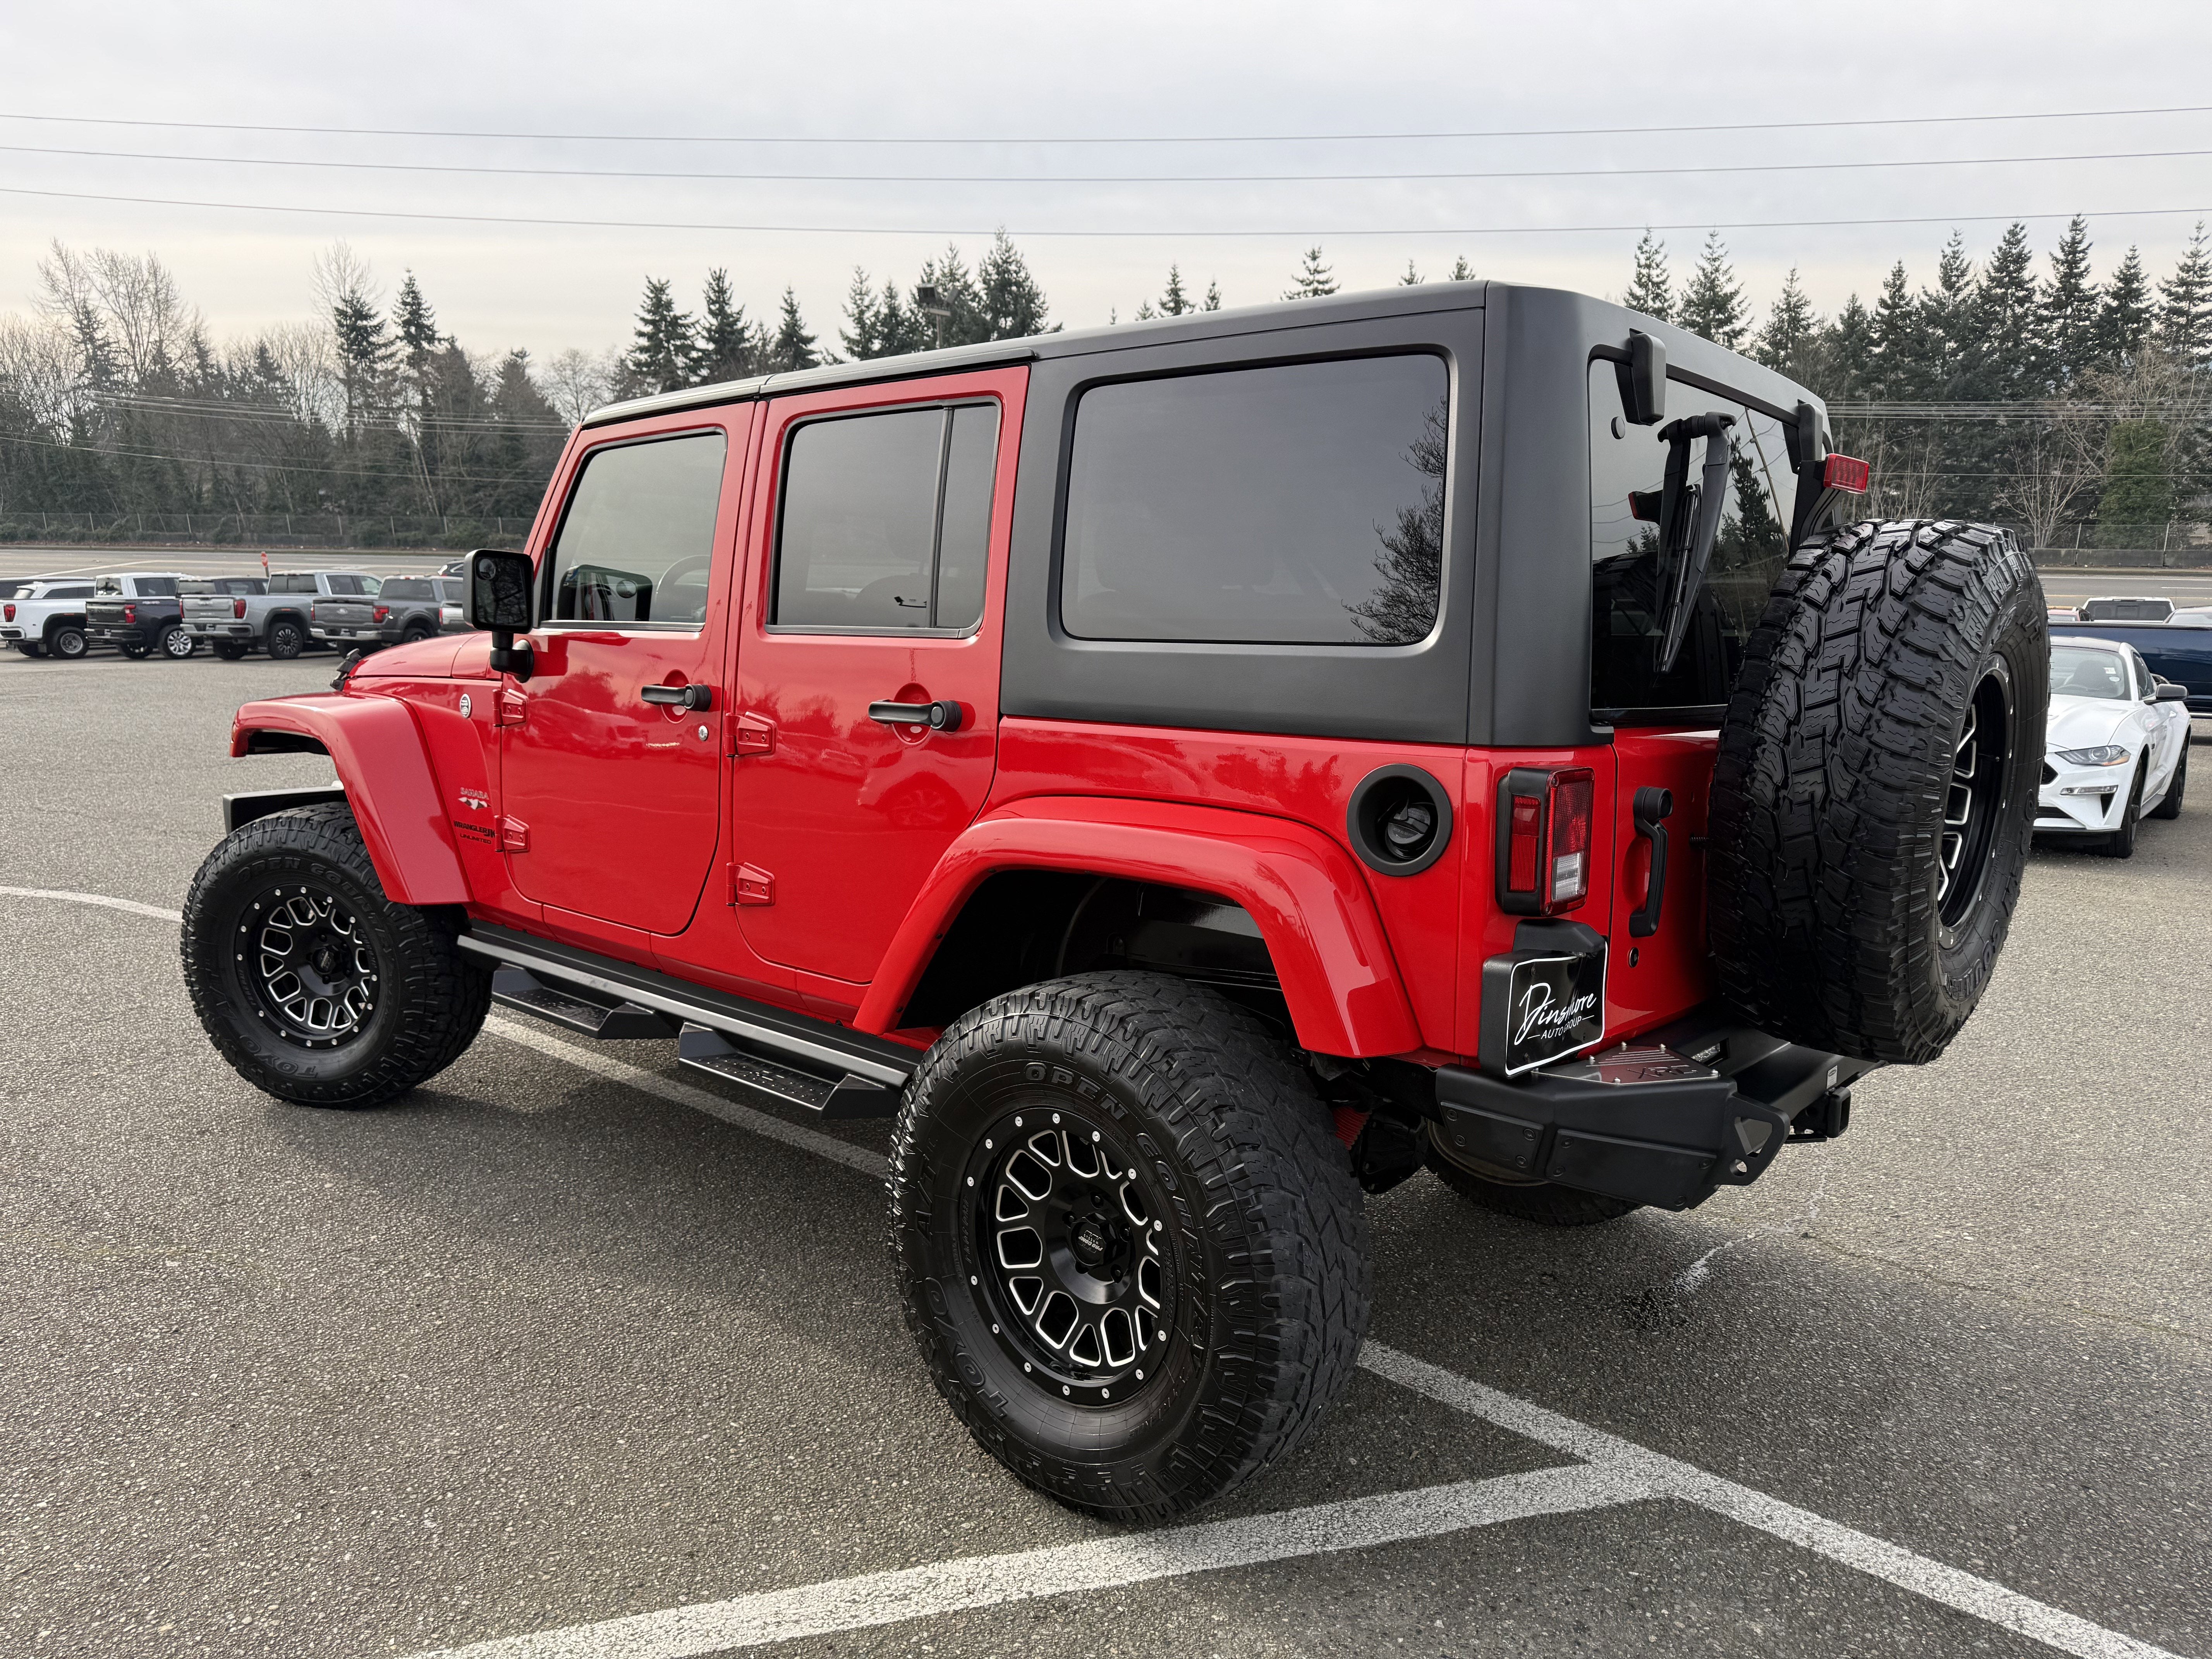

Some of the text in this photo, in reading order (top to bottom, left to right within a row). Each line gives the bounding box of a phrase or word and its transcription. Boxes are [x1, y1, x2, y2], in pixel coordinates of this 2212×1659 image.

[460, 833, 491, 844] UNLIMITED
[1514, 982, 1597, 1045] Dinsmore
[1541, 1027, 1563, 1039] AUTO
[240, 1035, 317, 1079] TOYO
[1024, 1062, 1129, 1120] OPEN
[925, 1276, 1009, 1419] TOYO
